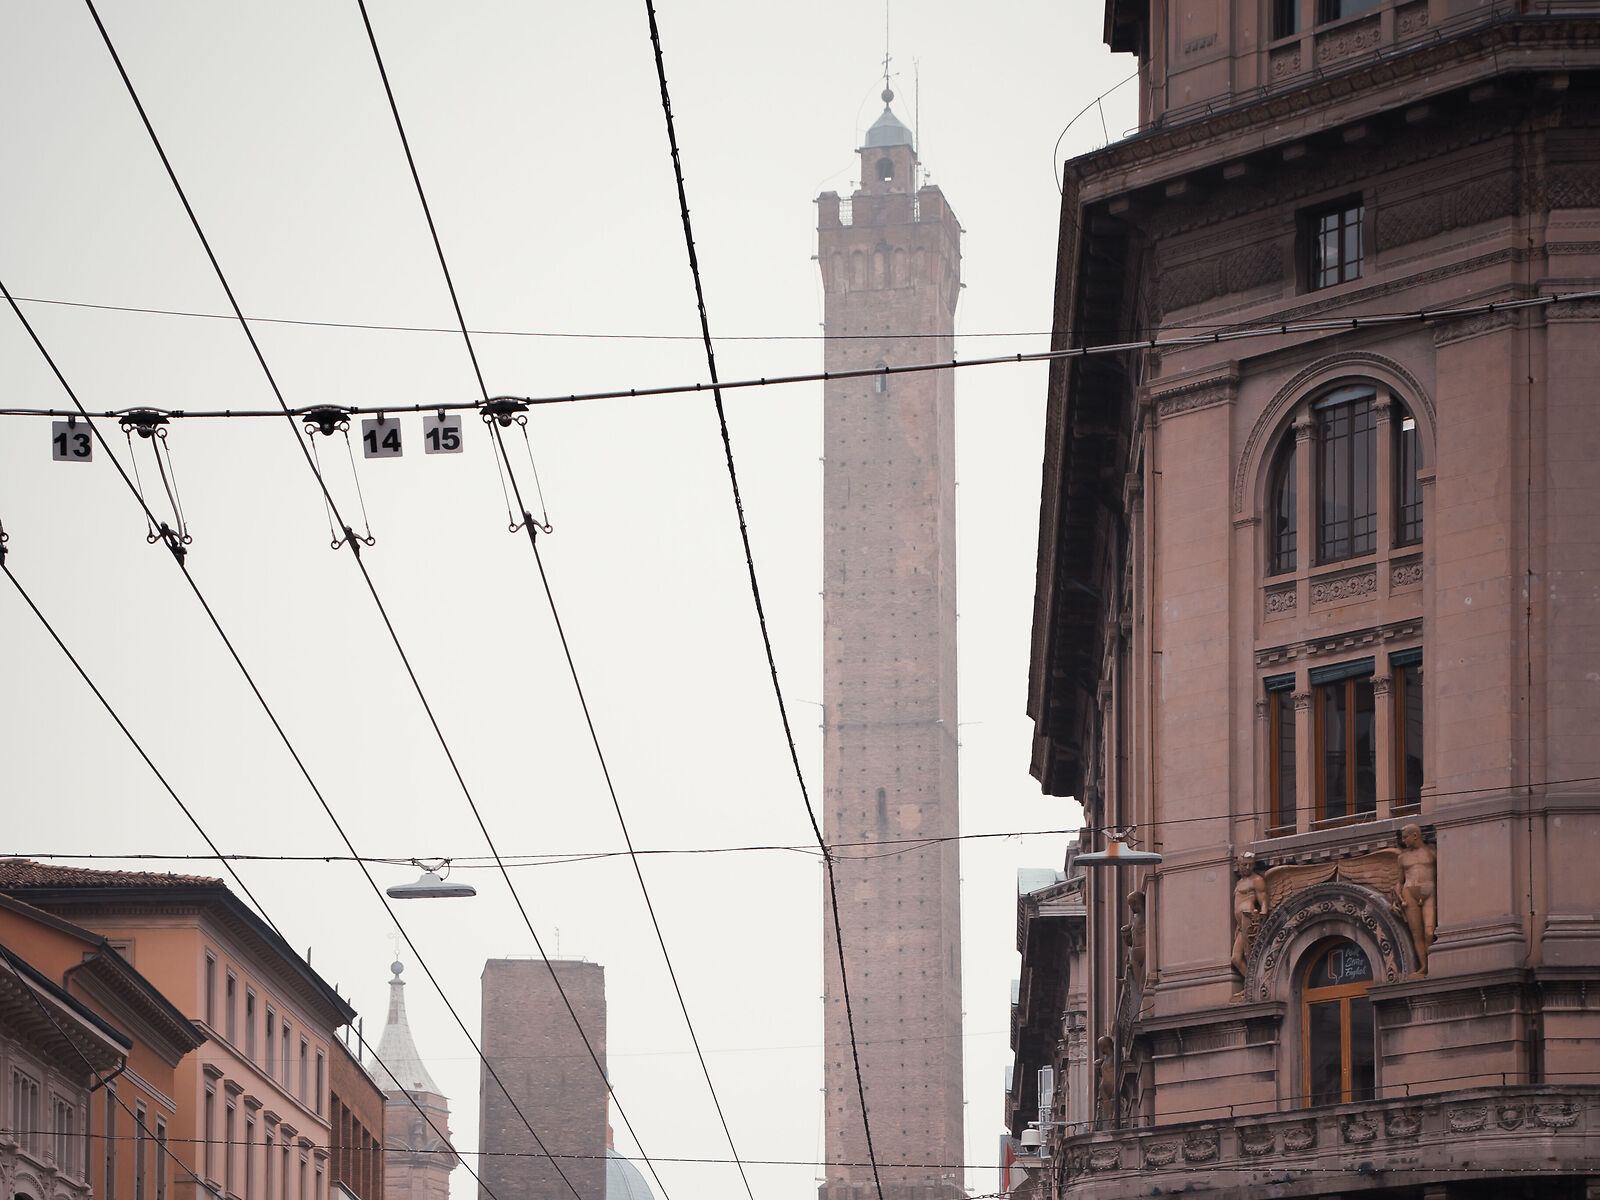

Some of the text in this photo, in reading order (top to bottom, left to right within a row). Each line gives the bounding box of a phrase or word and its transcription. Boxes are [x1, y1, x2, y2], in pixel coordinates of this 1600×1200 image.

[54, 433, 91, 457] 13
[364, 429, 401, 453] 14
[426, 427, 460, 450] 15
